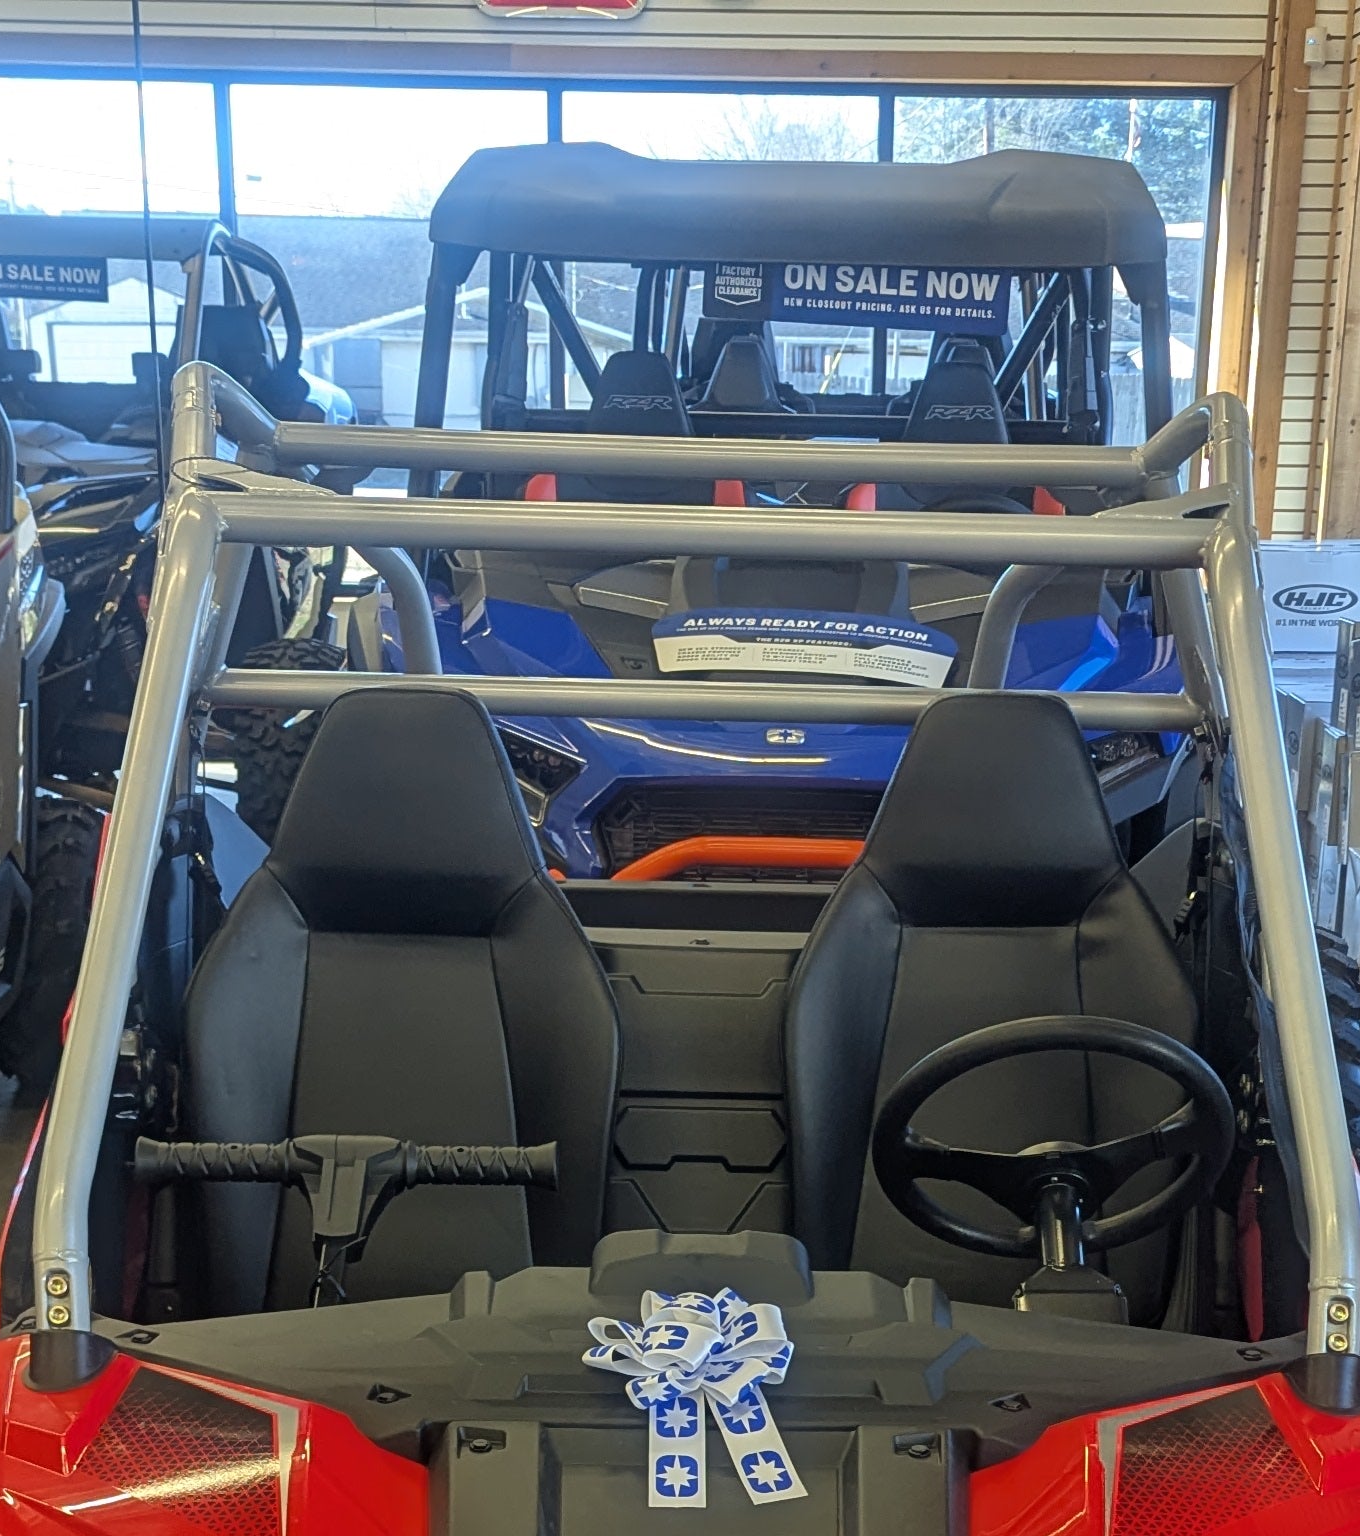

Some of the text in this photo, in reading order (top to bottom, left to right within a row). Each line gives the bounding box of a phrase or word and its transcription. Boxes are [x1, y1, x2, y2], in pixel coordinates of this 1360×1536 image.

[7, 263, 55, 282] SALE
[60, 267, 101, 285] NOW
[722, 266, 755, 277] FACTORY
[715, 276, 762, 287] AUTHORIZED
[784, 264, 1000, 301] ON SALE NOW
[718, 286, 758, 297] CLEARANCE
[784, 297, 803, 307] NEW
[806, 299, 852, 311] CLOSEOUT
[899, 304, 917, 314] ASK
[935, 306, 951, 316] FOR
[603, 394, 673, 410] RZR
[924, 405, 995, 420] RZR
[1283, 592, 1348, 607] HJC
[683, 617, 757, 627] ALWAYS
[760, 618, 821, 629] READY
[823, 621, 859, 632] FOR
[862, 625, 929, 641] ACTION
[1318, 619, 1339, 627] WOR
